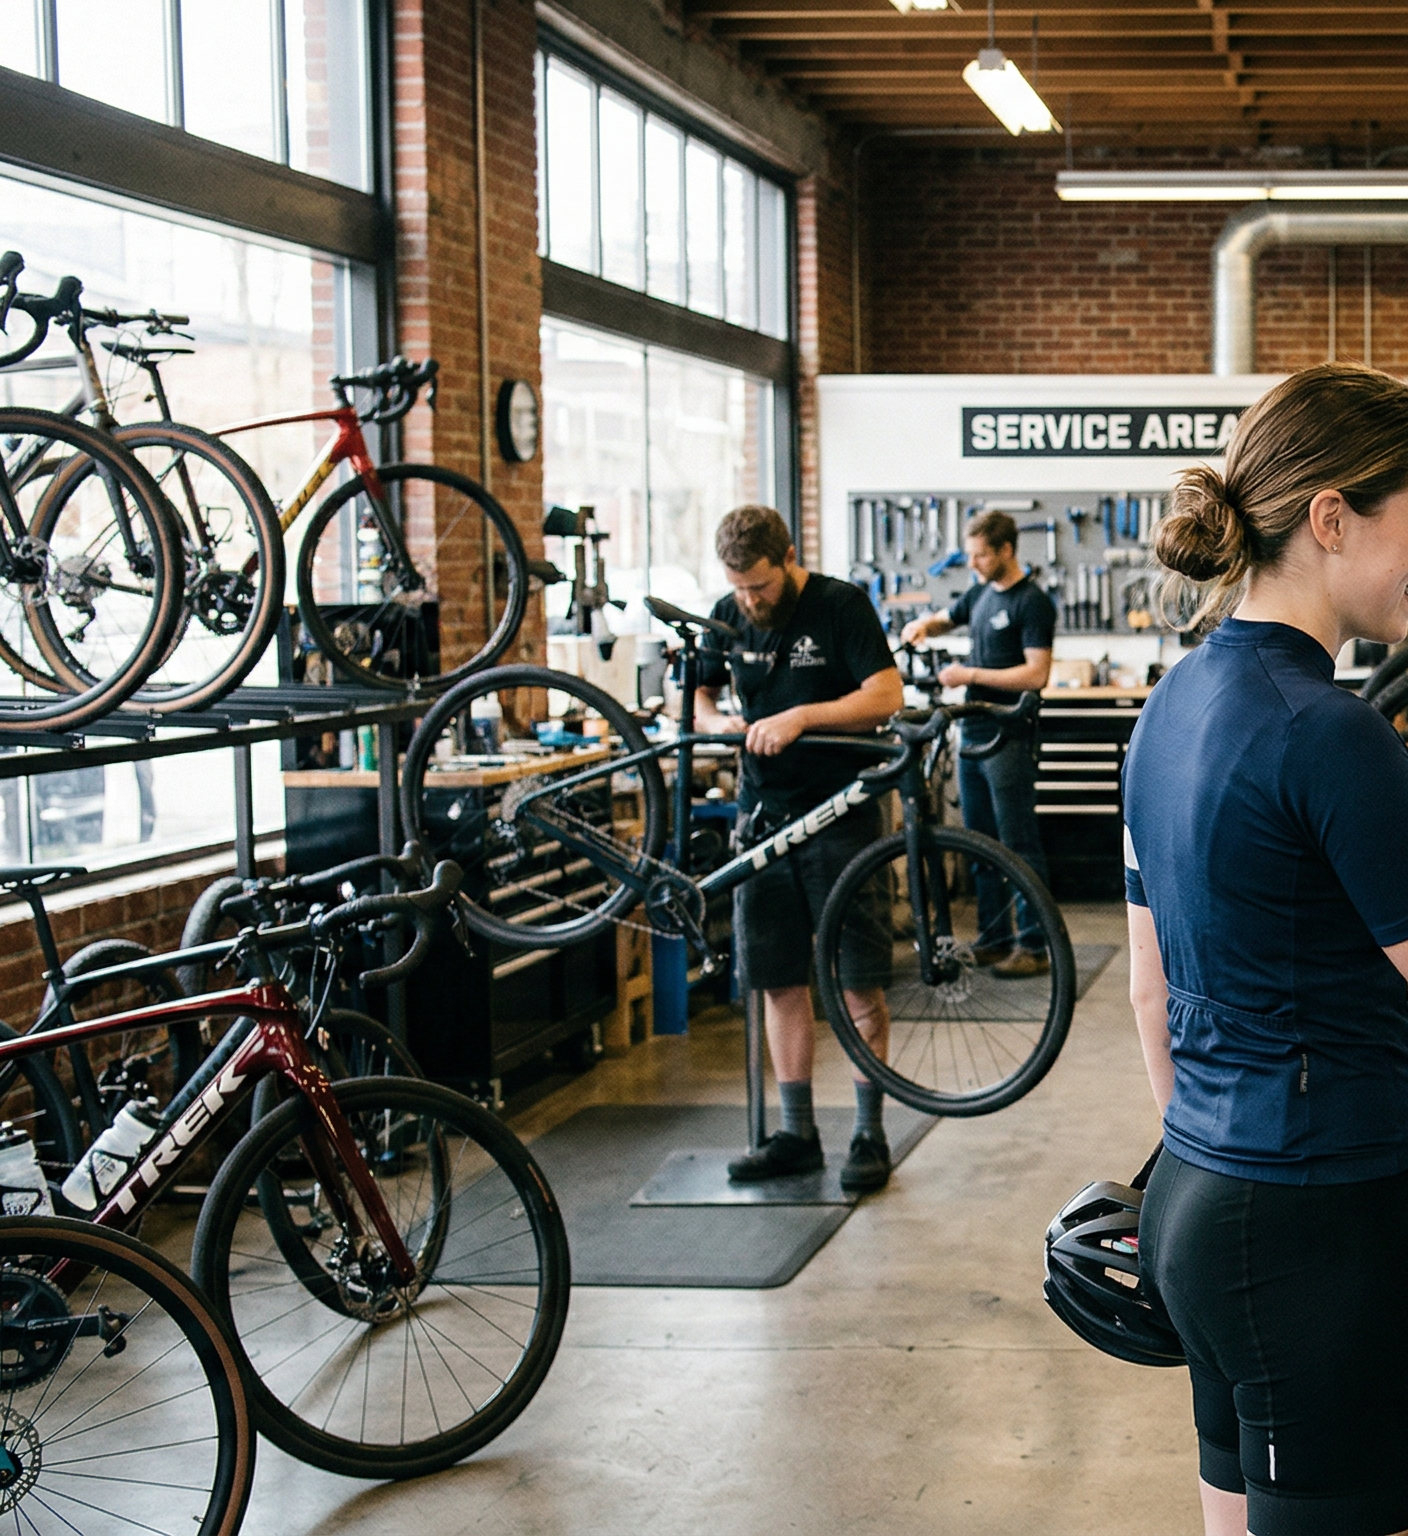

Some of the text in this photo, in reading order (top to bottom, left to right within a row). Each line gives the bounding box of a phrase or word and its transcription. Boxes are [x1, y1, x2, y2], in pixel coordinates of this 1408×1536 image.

[971, 413, 1240, 450] SERVICE AREA
[742, 780, 870, 871] TREK
[110, 1062, 248, 1215] TREK
